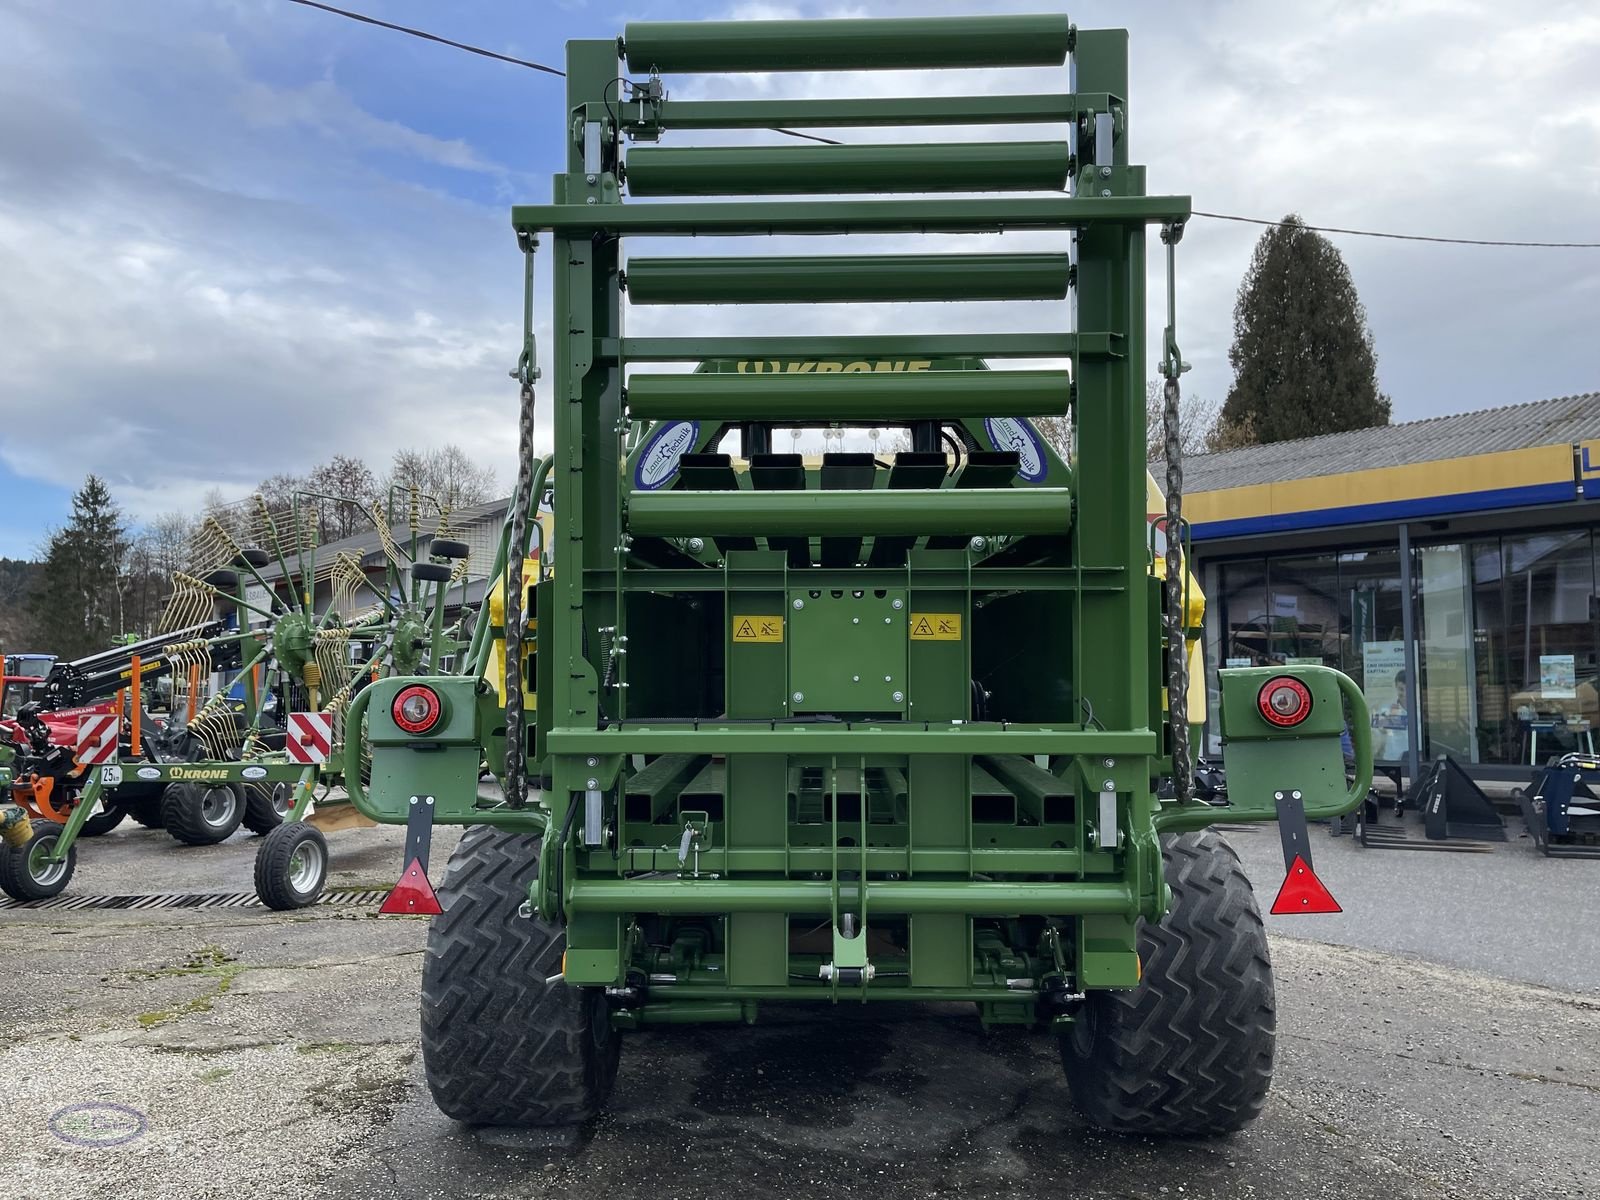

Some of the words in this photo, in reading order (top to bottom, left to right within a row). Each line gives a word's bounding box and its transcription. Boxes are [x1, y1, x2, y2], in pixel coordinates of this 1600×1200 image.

[645, 455, 663, 475] Land
[667, 427, 691, 455] Technik
[53, 706, 97, 718] WEIDEMANN
[103, 767, 113, 782] 25
[183, 769, 229, 779] KRONE
